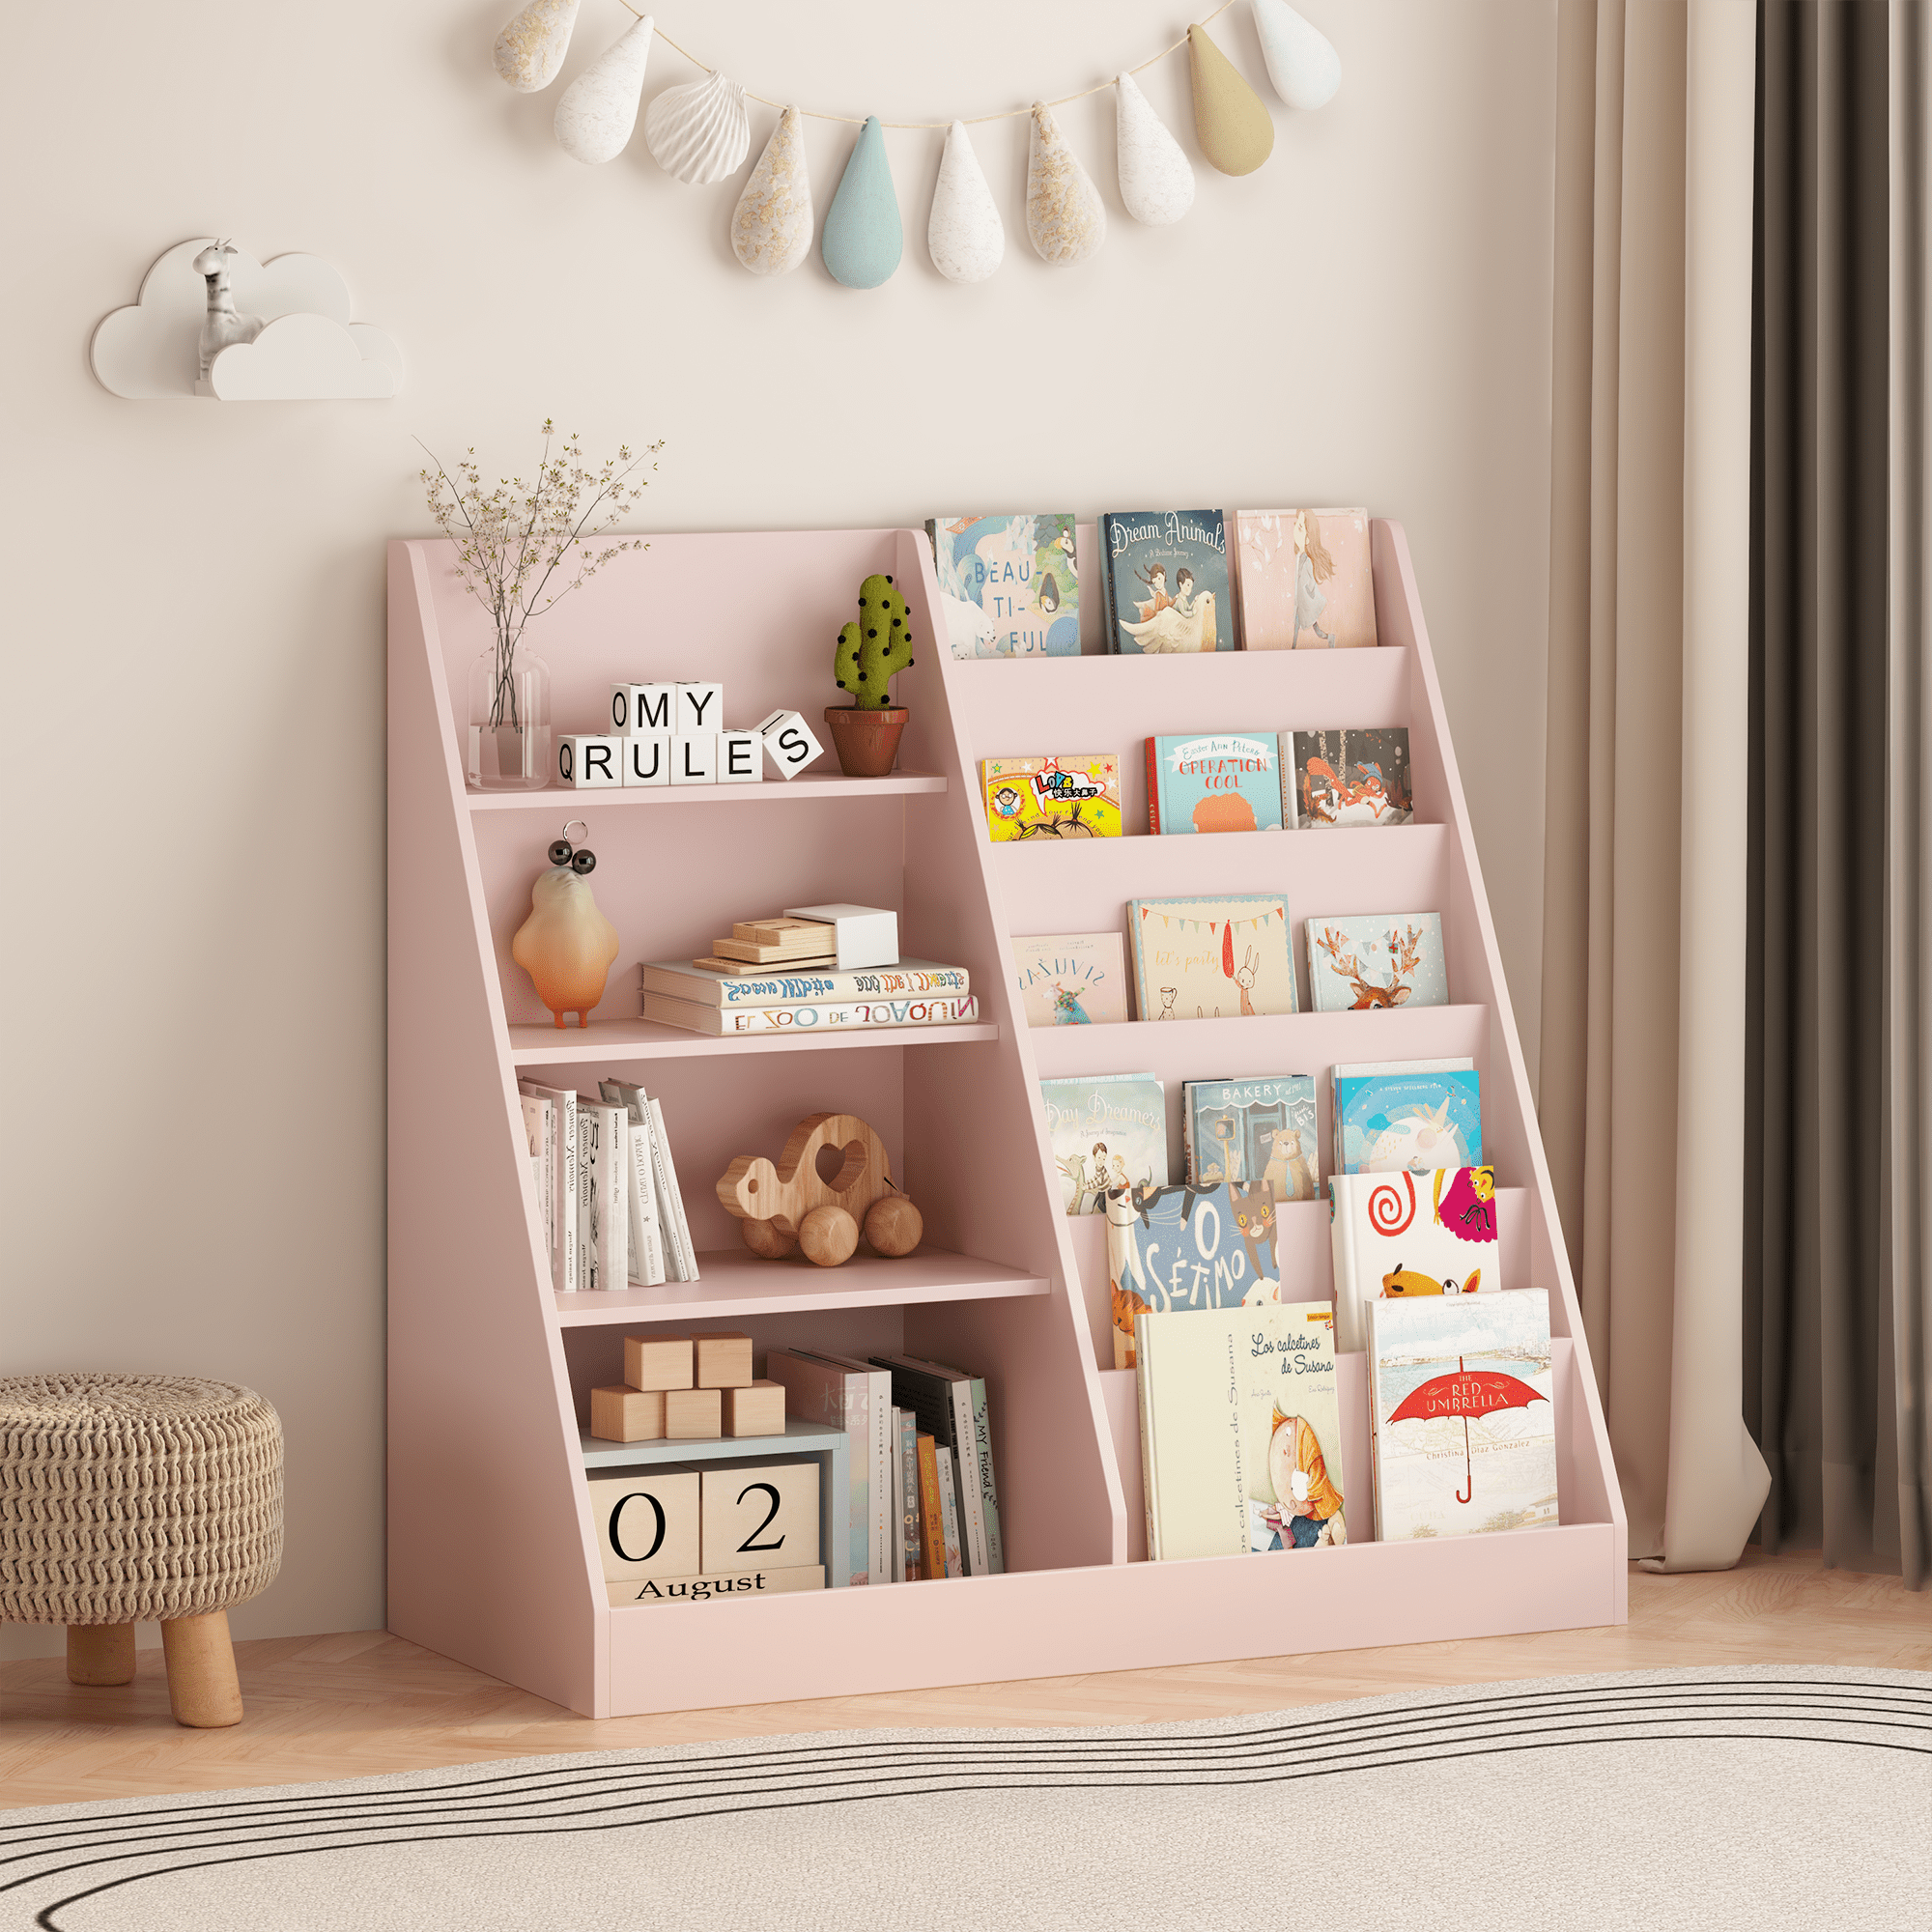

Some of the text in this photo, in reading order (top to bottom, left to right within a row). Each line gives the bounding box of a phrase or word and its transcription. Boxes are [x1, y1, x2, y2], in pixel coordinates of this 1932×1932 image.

[1110, 510, 1225, 558] Dream Animals
[975, 560, 1043, 583] BEAU-
[993, 596, 1026, 618] TI-
[1009, 631, 1047, 653] FUL
[637, 691, 715, 728] MY
[584, 728, 810, 781] RULES
[1179, 758, 1267, 776] OPERATION
[1052, 786, 1098, 799] 快乐大鼻子
[1205, 775, 1243, 790] COOL
[1155, 950, 1220, 975] let's party
[1222, 1084, 1282, 1100] BAKERY
[1043, 1089, 1161, 1132] Day Dreamers
[1194, 1201, 1220, 1261] O
[1251, 1332, 1321, 1357] Los calcetines
[1227, 1333, 1238, 1406] Susana
[1281, 1353, 1334, 1376] de Susana
[1452, 1381, 1482, 1397] RED
[1459, 1374, 1473, 1382] THE
[1426, 1393, 1509, 1412] UMBRELLA
[1230, 1411, 1238, 1434] de
[976, 1425, 993, 1489] MY Friend
[1426, 1449, 1464, 1461] Christina
[1234, 1439, 1245, 1529] calcetines
[634, 1573, 767, 1601] August
